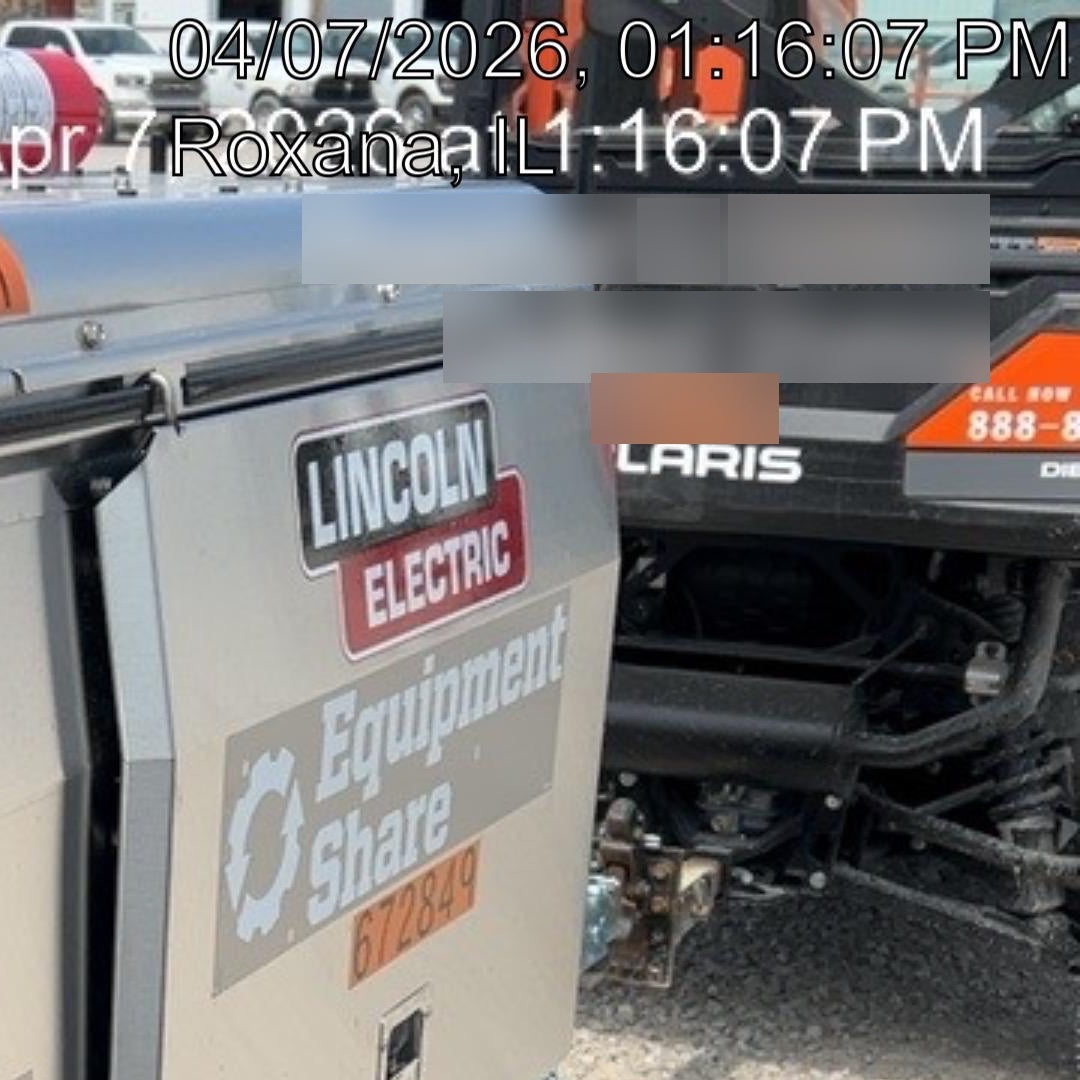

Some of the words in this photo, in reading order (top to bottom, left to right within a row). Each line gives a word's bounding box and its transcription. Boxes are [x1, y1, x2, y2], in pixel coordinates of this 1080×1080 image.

[969, 385, 1018, 403] CALL
[1025, 385, 1072, 403] NOW
[306, 420, 490, 549] LINCOLN
[364, 518, 512, 629] ELECTRIC
[316, 603, 569, 803] Equipment
[307, 780, 453, 926] Share
[353, 849, 477, 979] 672849
